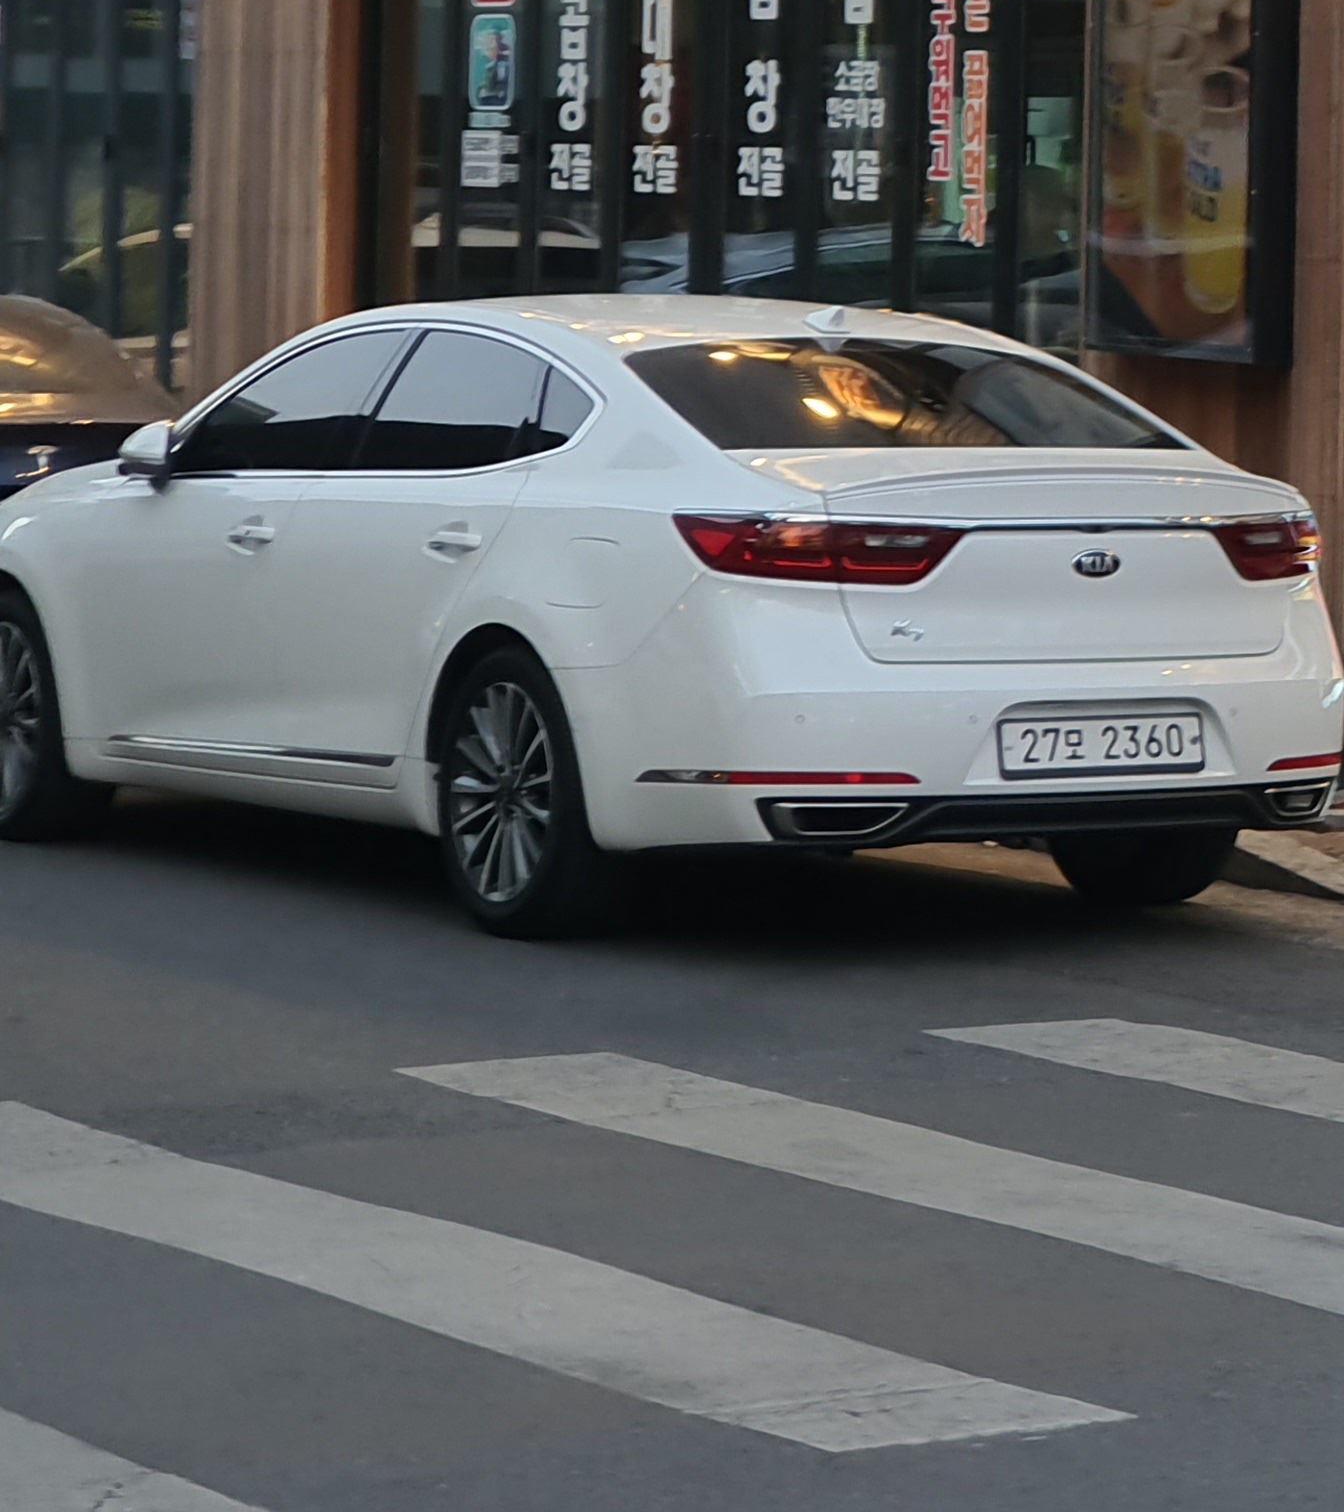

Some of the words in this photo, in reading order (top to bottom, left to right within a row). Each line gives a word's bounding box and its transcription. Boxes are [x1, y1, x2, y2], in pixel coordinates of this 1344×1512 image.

[549, 142, 593, 192] 전골
[632, 143, 679, 195] 전골
[736, 146, 785, 198] 전골
[831, 149, 882, 202] 전골
[1080, 555, 1114, 574] KIA
[1019, 727, 1086, 764] 27모
[1101, 723, 1185, 761] 2360
